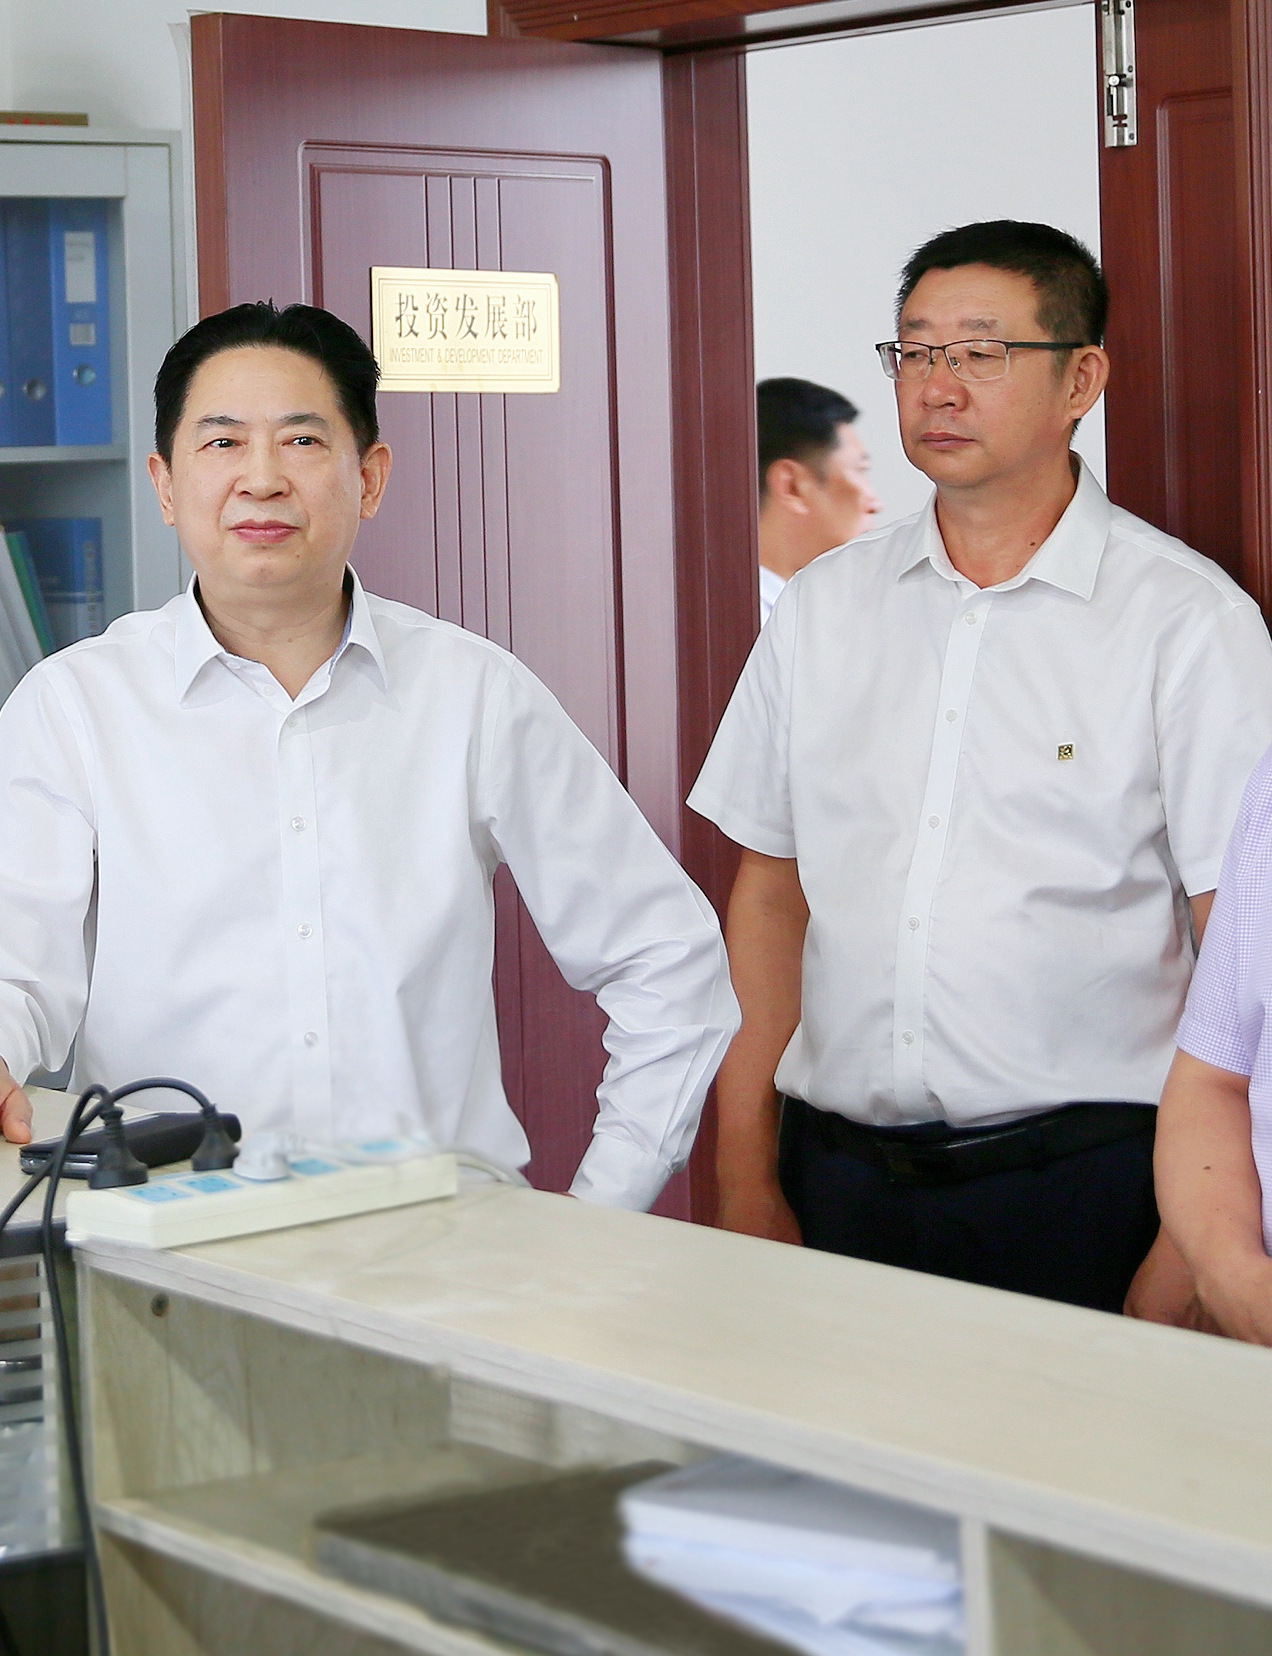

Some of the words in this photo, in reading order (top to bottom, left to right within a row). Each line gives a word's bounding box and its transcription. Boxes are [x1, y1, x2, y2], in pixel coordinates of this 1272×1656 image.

[395, 292, 537, 342] 投资发展部
[389, 347, 434, 363] INVESTMENT
[437, 348, 442, 363] &
[444, 347, 495, 364] DEVELOPMENT
[498, 348, 543, 364] DEPARTMENT
